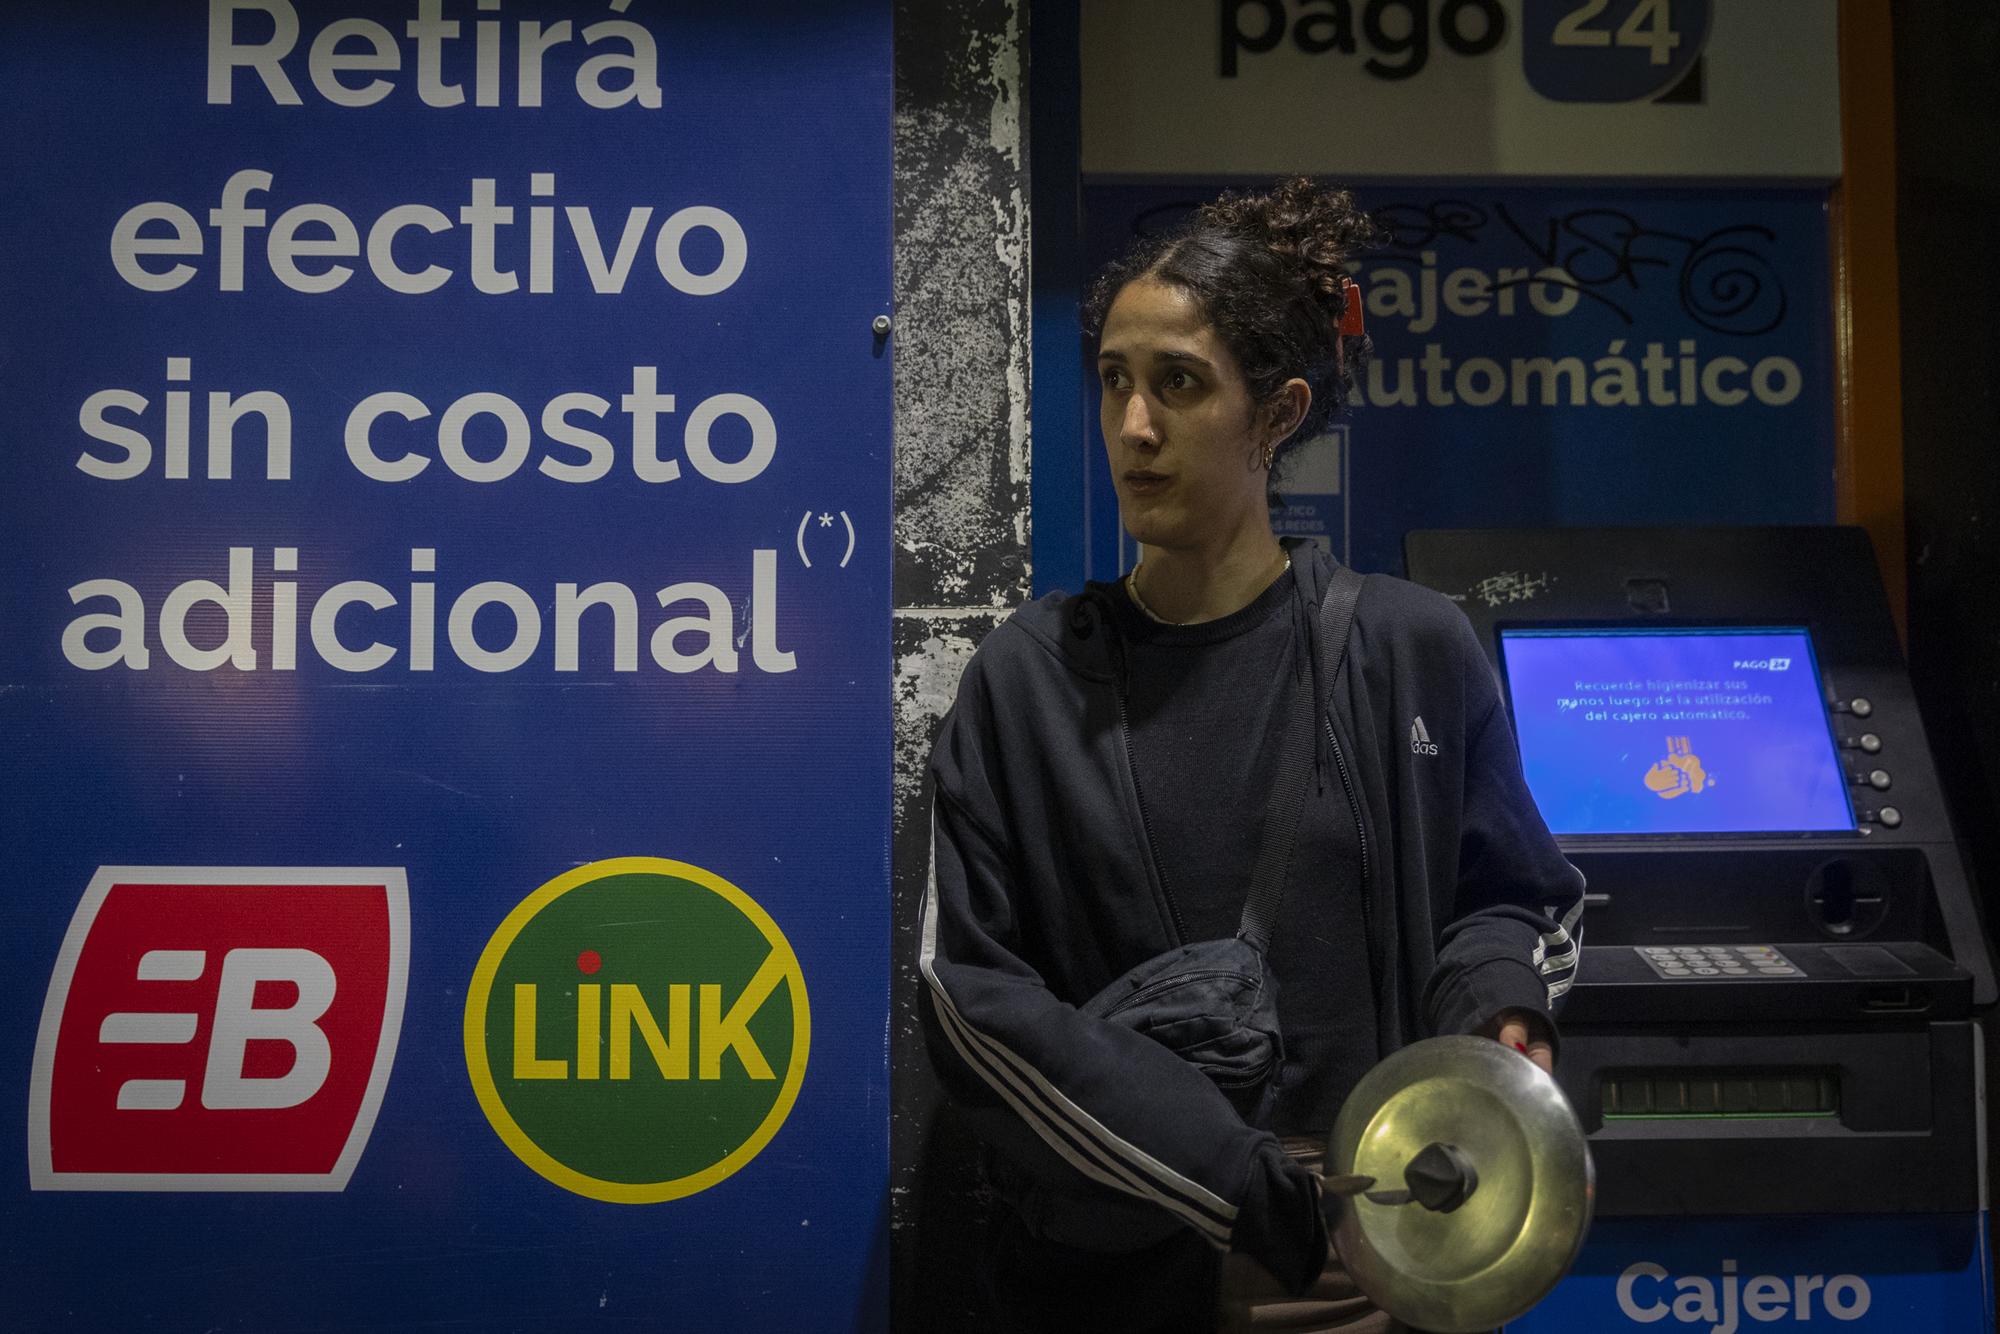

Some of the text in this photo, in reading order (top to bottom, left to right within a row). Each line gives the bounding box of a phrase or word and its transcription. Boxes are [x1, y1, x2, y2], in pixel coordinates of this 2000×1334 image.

[207, 0, 662, 109] Retirá
[1219, 0, 1507, 81] pago
[111, 170, 747, 295] efectivo
[1344, 251, 1580, 333] ajero
[76, 358, 777, 483] sin costo
[62, 548, 797, 673] adicional
[1575, 680, 1748, 692] Recuerde higienizar sus
[1609, 696, 1650, 708] luego
[1655, 695, 1672, 705] de
[1677, 694, 1691, 705] la
[1695, 693, 1773, 705] utilización
[1733, 660, 1768, 669] PAGO
[1585, 711, 1608, 721] del
[1612, 711, 1657, 723] cajero
[1616, 1259, 1871, 1334] Cajero
